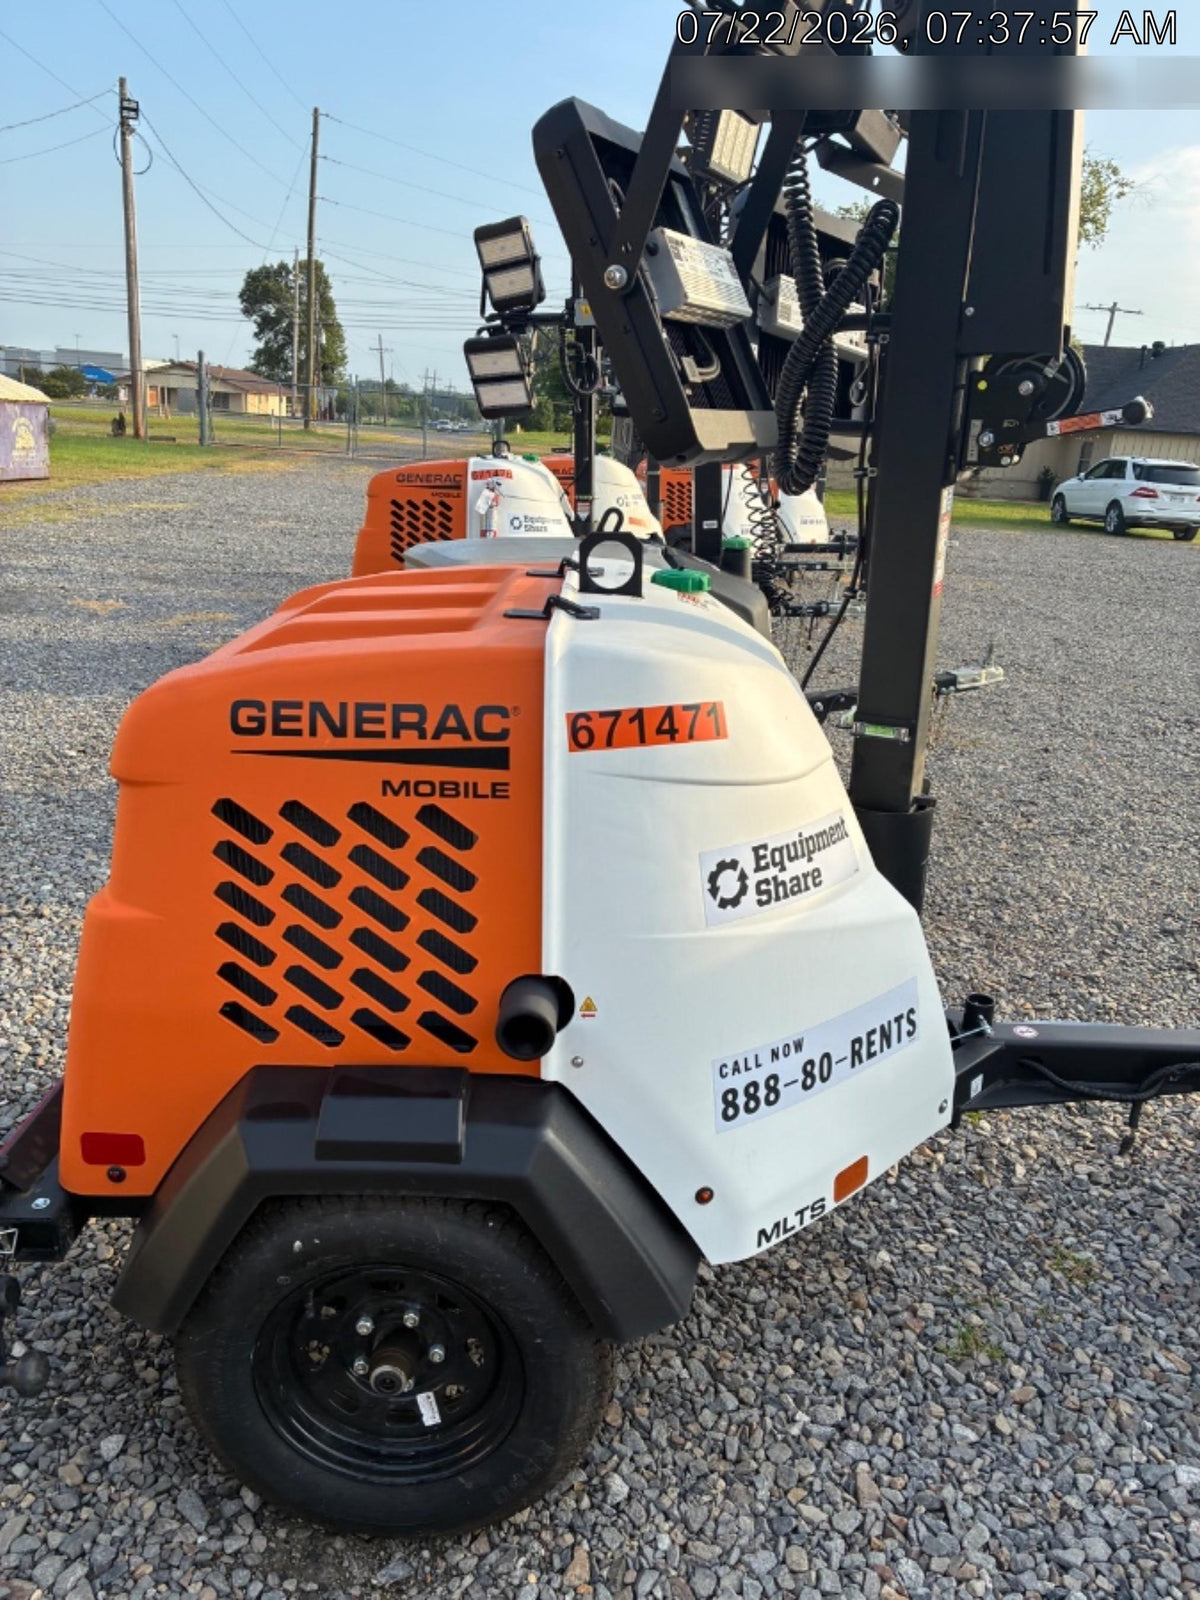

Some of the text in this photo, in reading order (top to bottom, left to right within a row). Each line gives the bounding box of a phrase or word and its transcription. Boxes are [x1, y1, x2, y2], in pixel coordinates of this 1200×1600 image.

[396, 474, 462, 483] GENERAC
[230, 699, 511, 741] GENERAC
[570, 702, 721, 749] 671471
[381, 780, 510, 799] MOBILE
[751, 816, 849, 873] Equipment
[755, 867, 823, 907] Share
[719, 1037, 804, 1079] CALL NOW
[721, 1007, 917, 1122] 888-80-RENTS
[757, 1196, 826, 1248] MLTS
